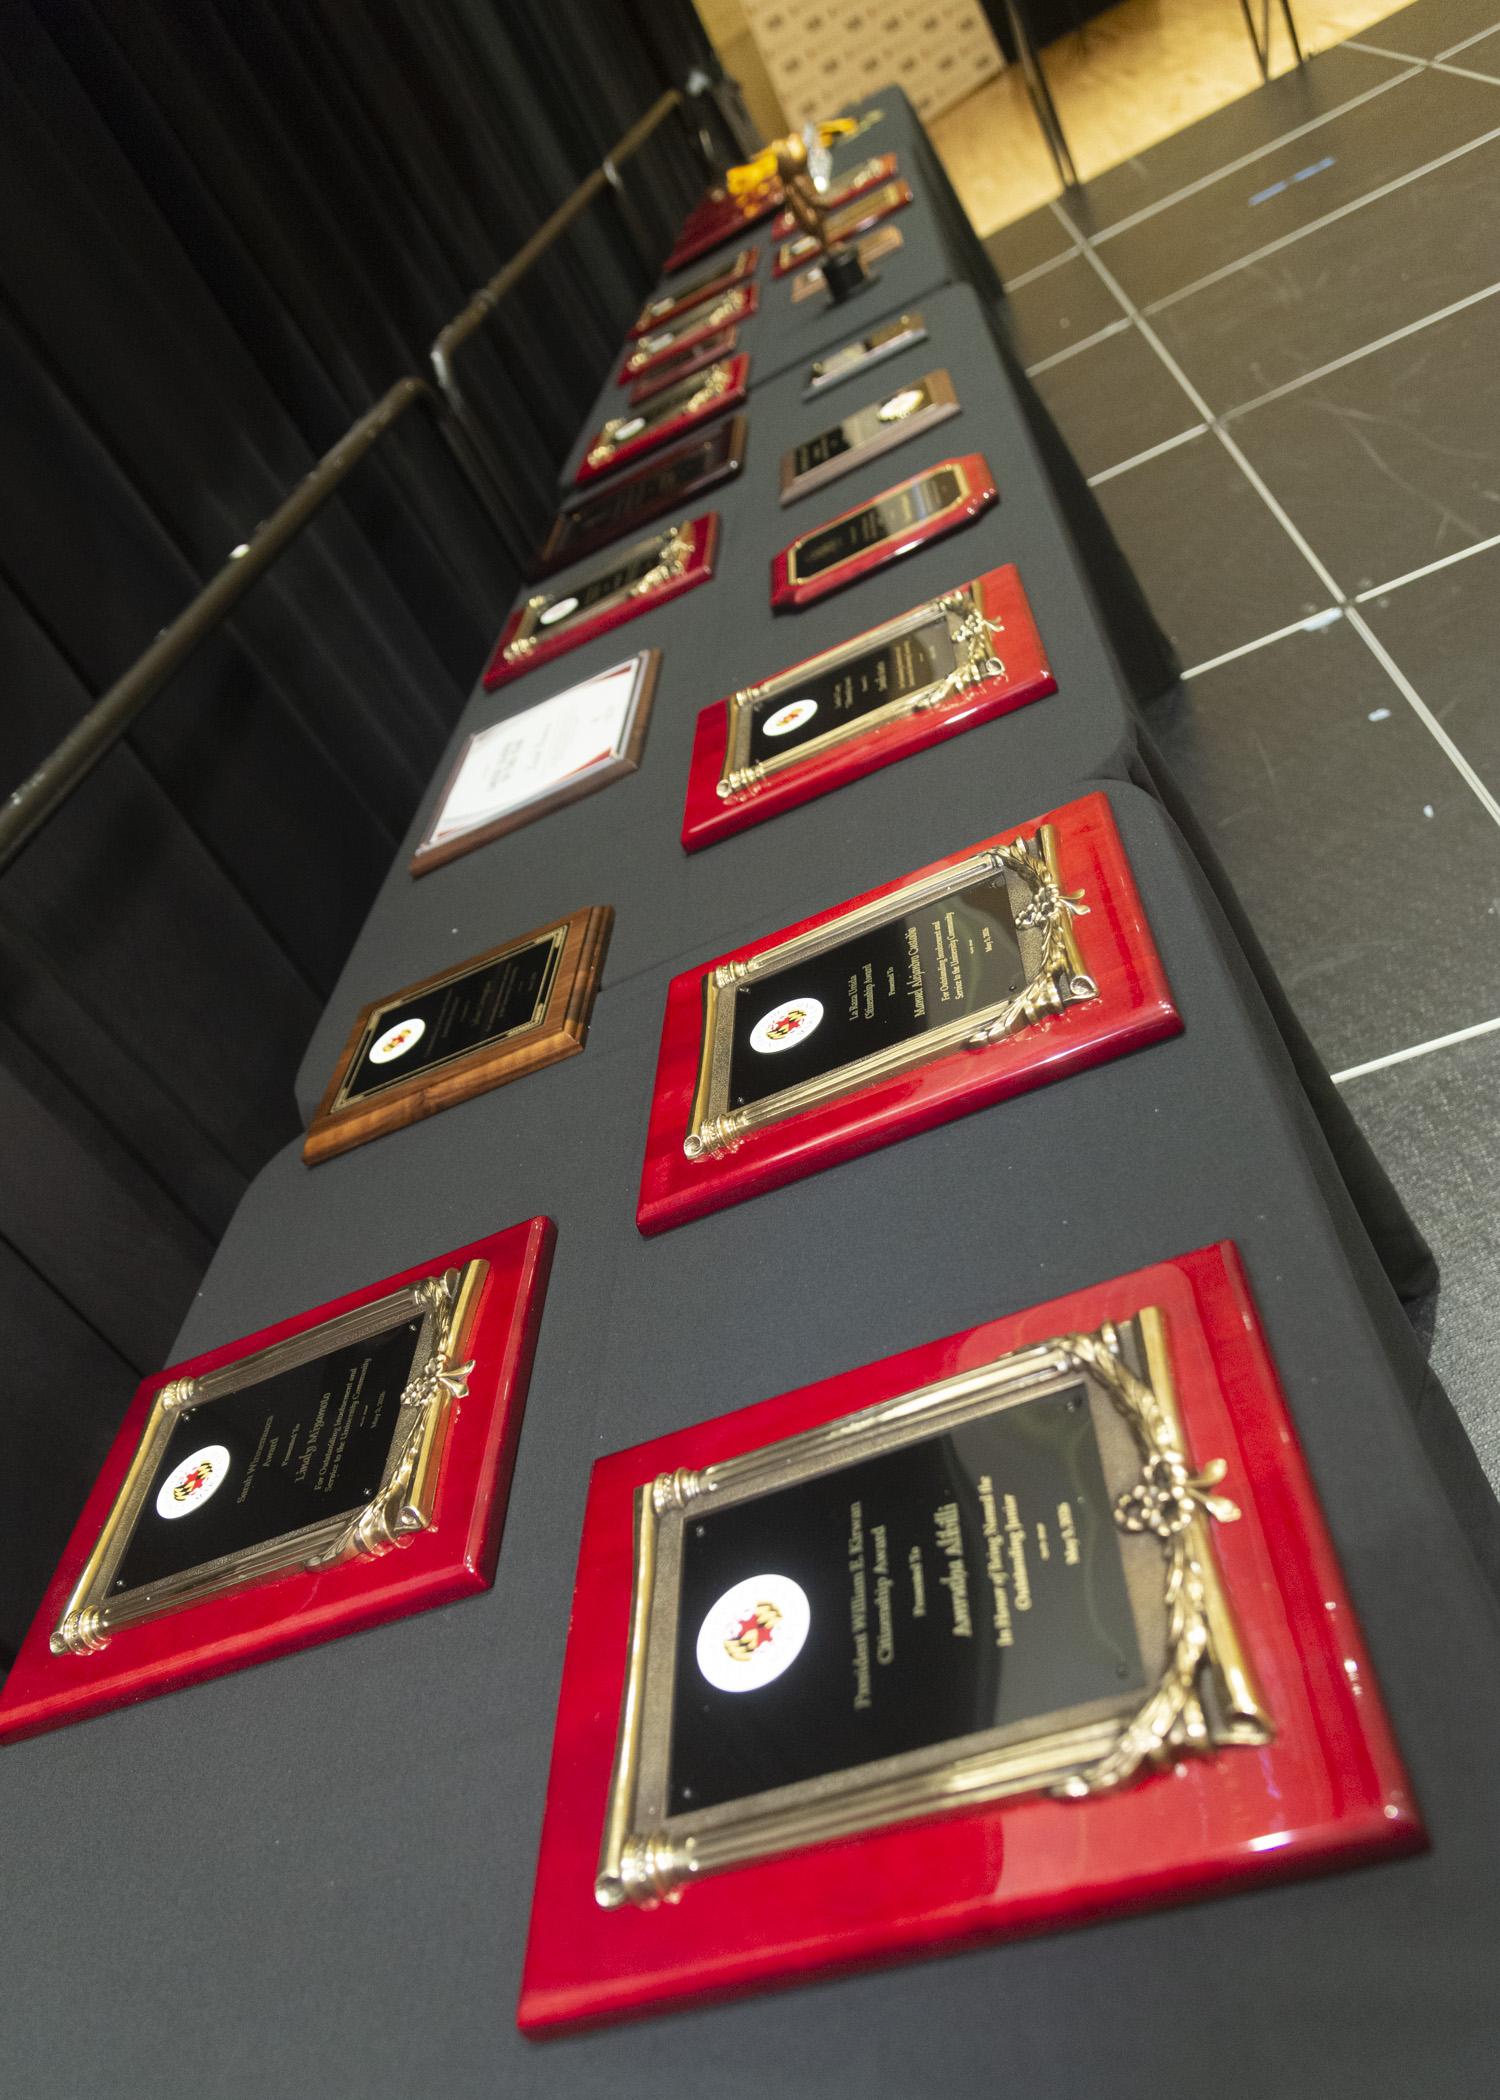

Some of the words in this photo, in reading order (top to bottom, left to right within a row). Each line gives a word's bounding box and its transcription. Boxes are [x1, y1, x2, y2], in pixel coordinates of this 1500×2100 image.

[905, 926, 918, 955] Custodio
[944, 912, 955, 940] Community
[934, 930, 944, 960] Involvement
[949, 939, 959, 966] University
[848, 975, 857, 995] Unida
[862, 964, 872, 984] Award
[887, 973, 895, 996] Presented
[906, 952, 925, 987] Alejandro
[938, 958, 948, 991] Outstanding
[849, 994, 858, 1010] Raza
[864, 984, 874, 1019] Citizenship
[908, 988, 925, 1017] Manuel
[954, 980, 964, 999] Service
[325, 1464, 338, 1492] Service
[340, 1401, 359, 1440] University
[352, 1358, 371, 1399] Community
[237, 1475, 253, 1503] Sarah
[247, 1416, 274, 1474] Winnemucca
[262, 1437, 278, 1466] Award
[282, 1434, 297, 1466] Presented
[319, 1426, 341, 1475] Outstanding
[977, 1475, 993, 1494] the
[848, 1501, 864, 1555] Kirwan
[979, 1491, 999, 1537] Named
[1002, 1493, 1023, 1532] Junior
[849, 1554, 865, 1572] E.
[870, 1524, 889, 1575] Award
[908, 1545, 921, 1564] To
[987, 1534, 1004, 1574] Being
[1064, 1537, 1079, 1565] May
[988, 1567, 1010, 1587] of
[1007, 1529, 1032, 1611] Outstanding
[850, 1570, 867, 1633] William
[909, 1562, 925, 1617] Presented
[874, 1576, 894, 1665] Citizenship
[993, 1583, 1012, 1629] Honor
[997, 1627, 1014, 1647] In
[853, 1631, 871, 1709] President
